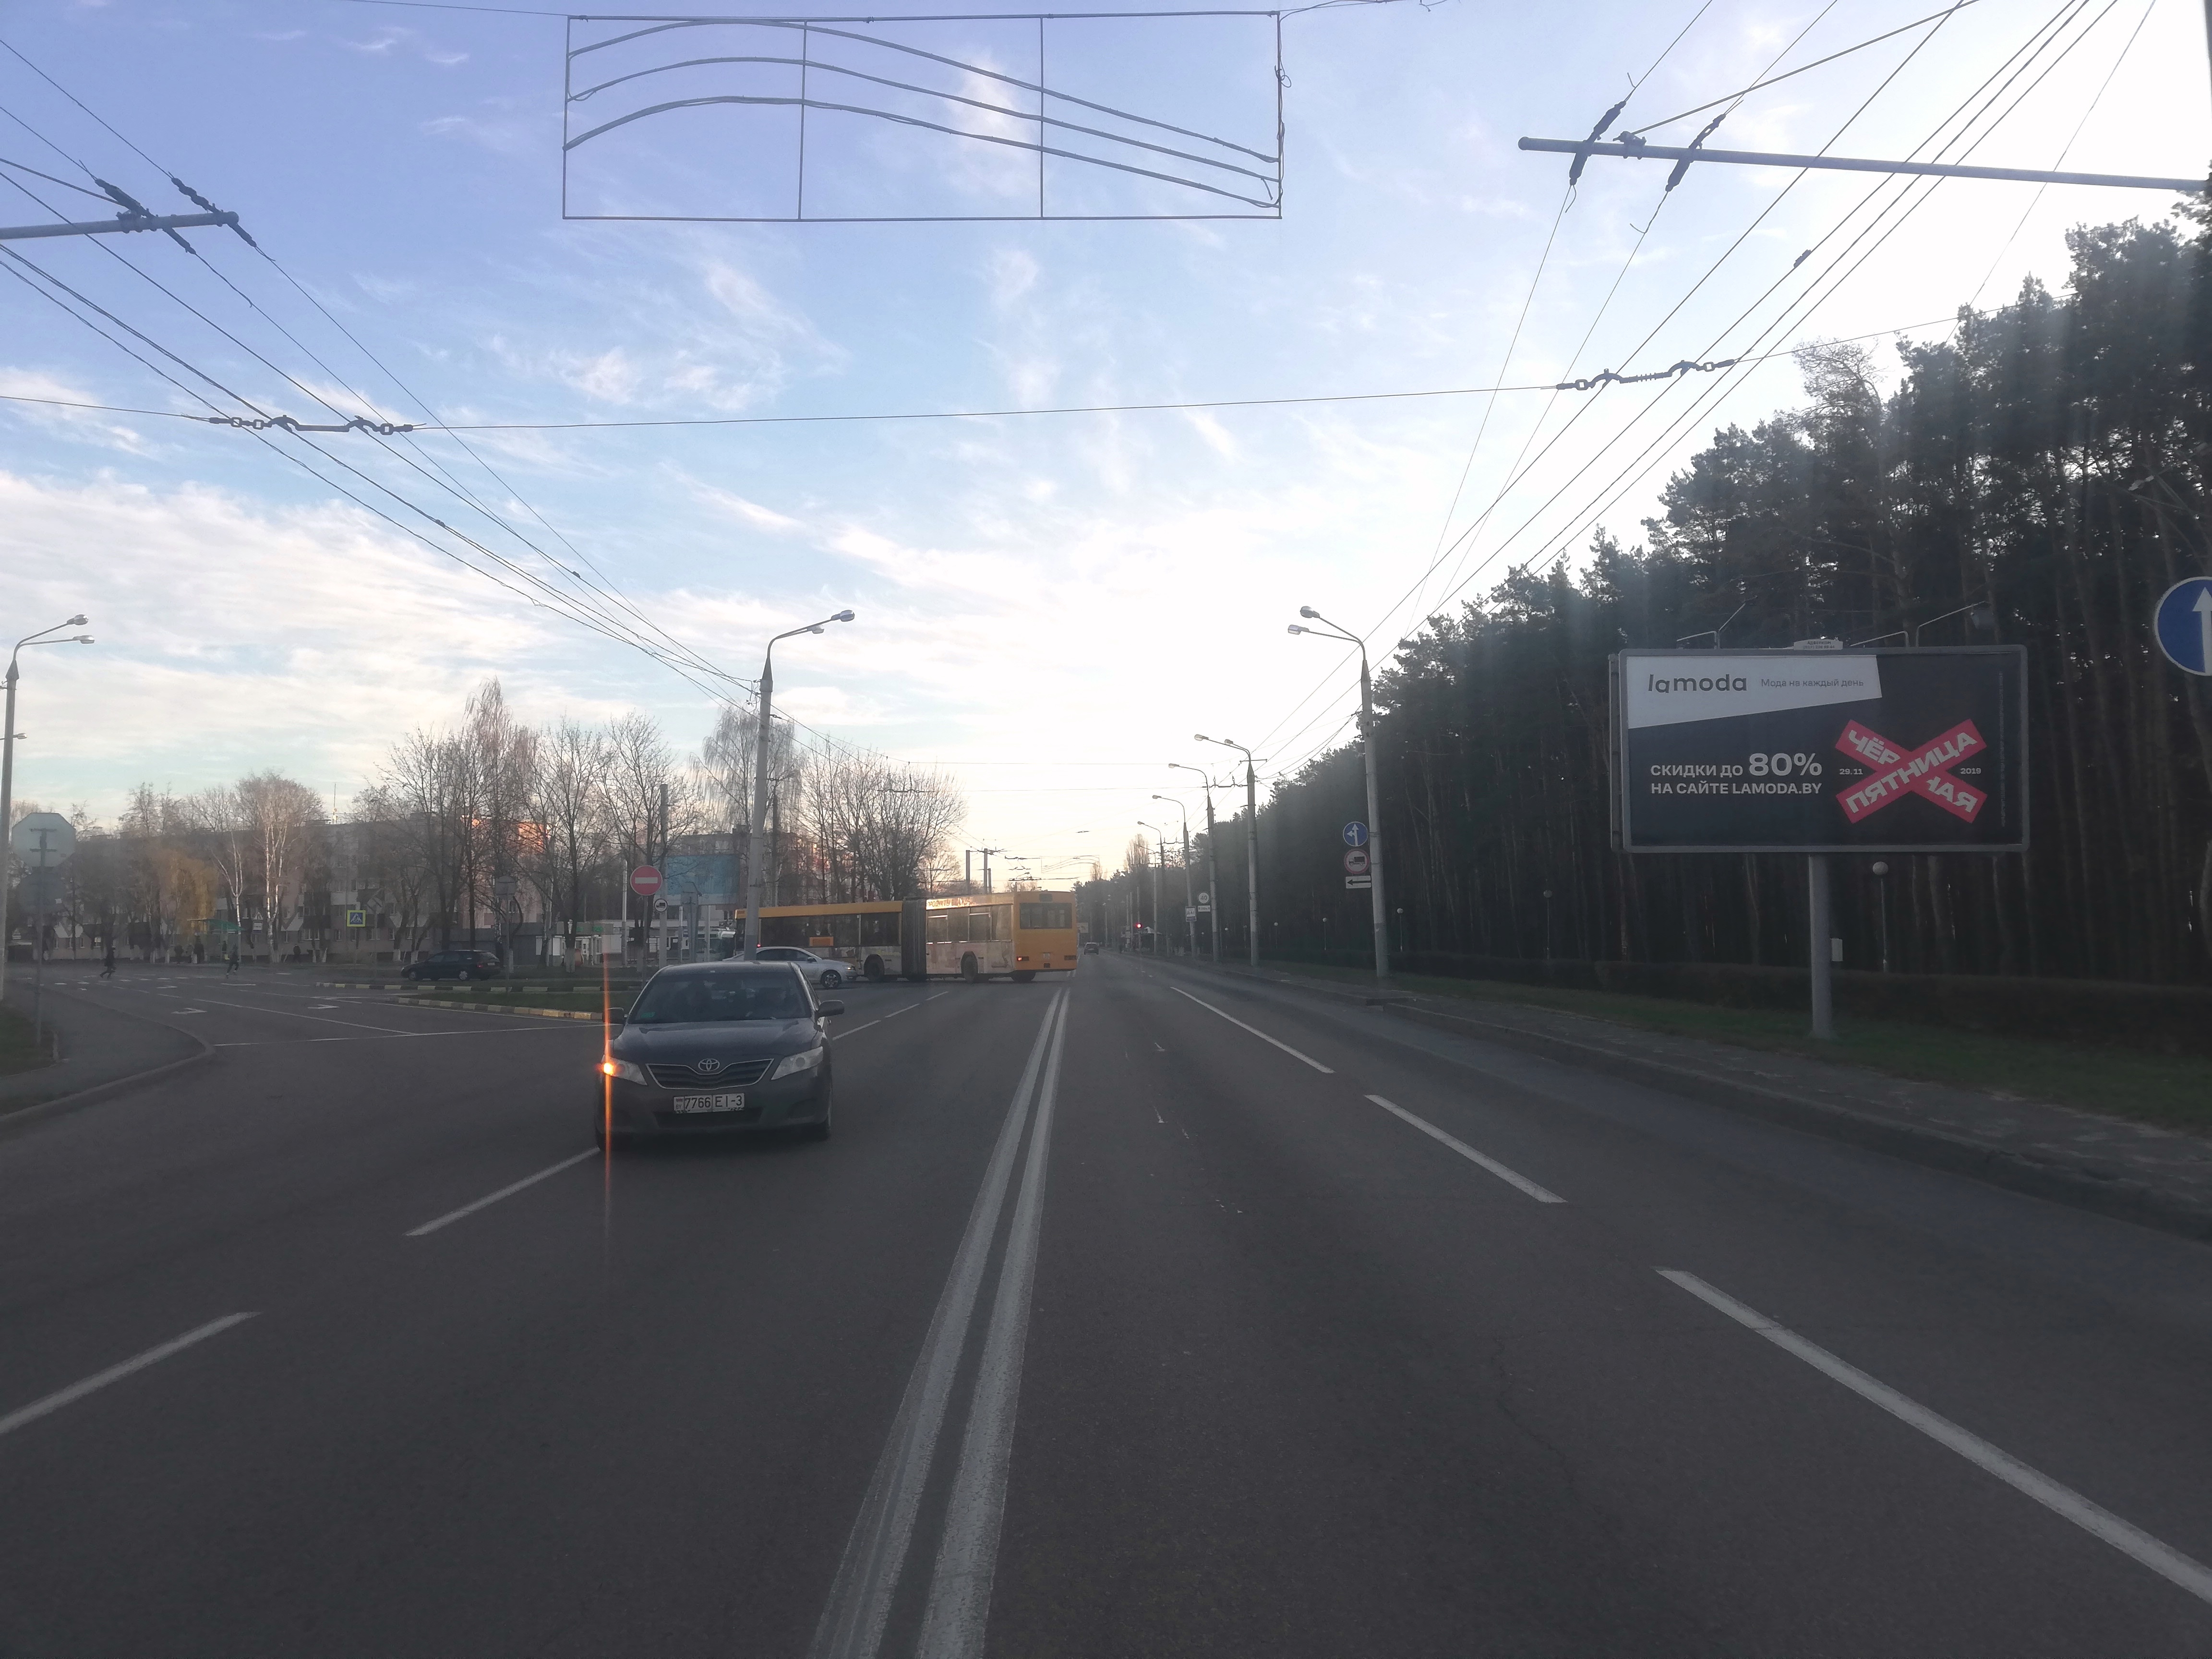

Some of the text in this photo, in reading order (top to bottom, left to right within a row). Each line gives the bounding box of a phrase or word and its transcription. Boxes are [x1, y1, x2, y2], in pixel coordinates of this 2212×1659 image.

[1648, 674, 1747, 693] lamoda
[1761, 679, 1787, 688] Мода
[1803, 678, 1839, 688] каждый
[1848, 730, 1901, 764] ЧЁР
[1650, 753, 1823, 778] СКИДКИ ДО 80%
[1846, 732, 1978, 813] ПЯТНИЦА
[1651, 780, 1822, 794] НА САЙТЕ LAMODA.BY
[685, 1097, 711, 1109] 7766
